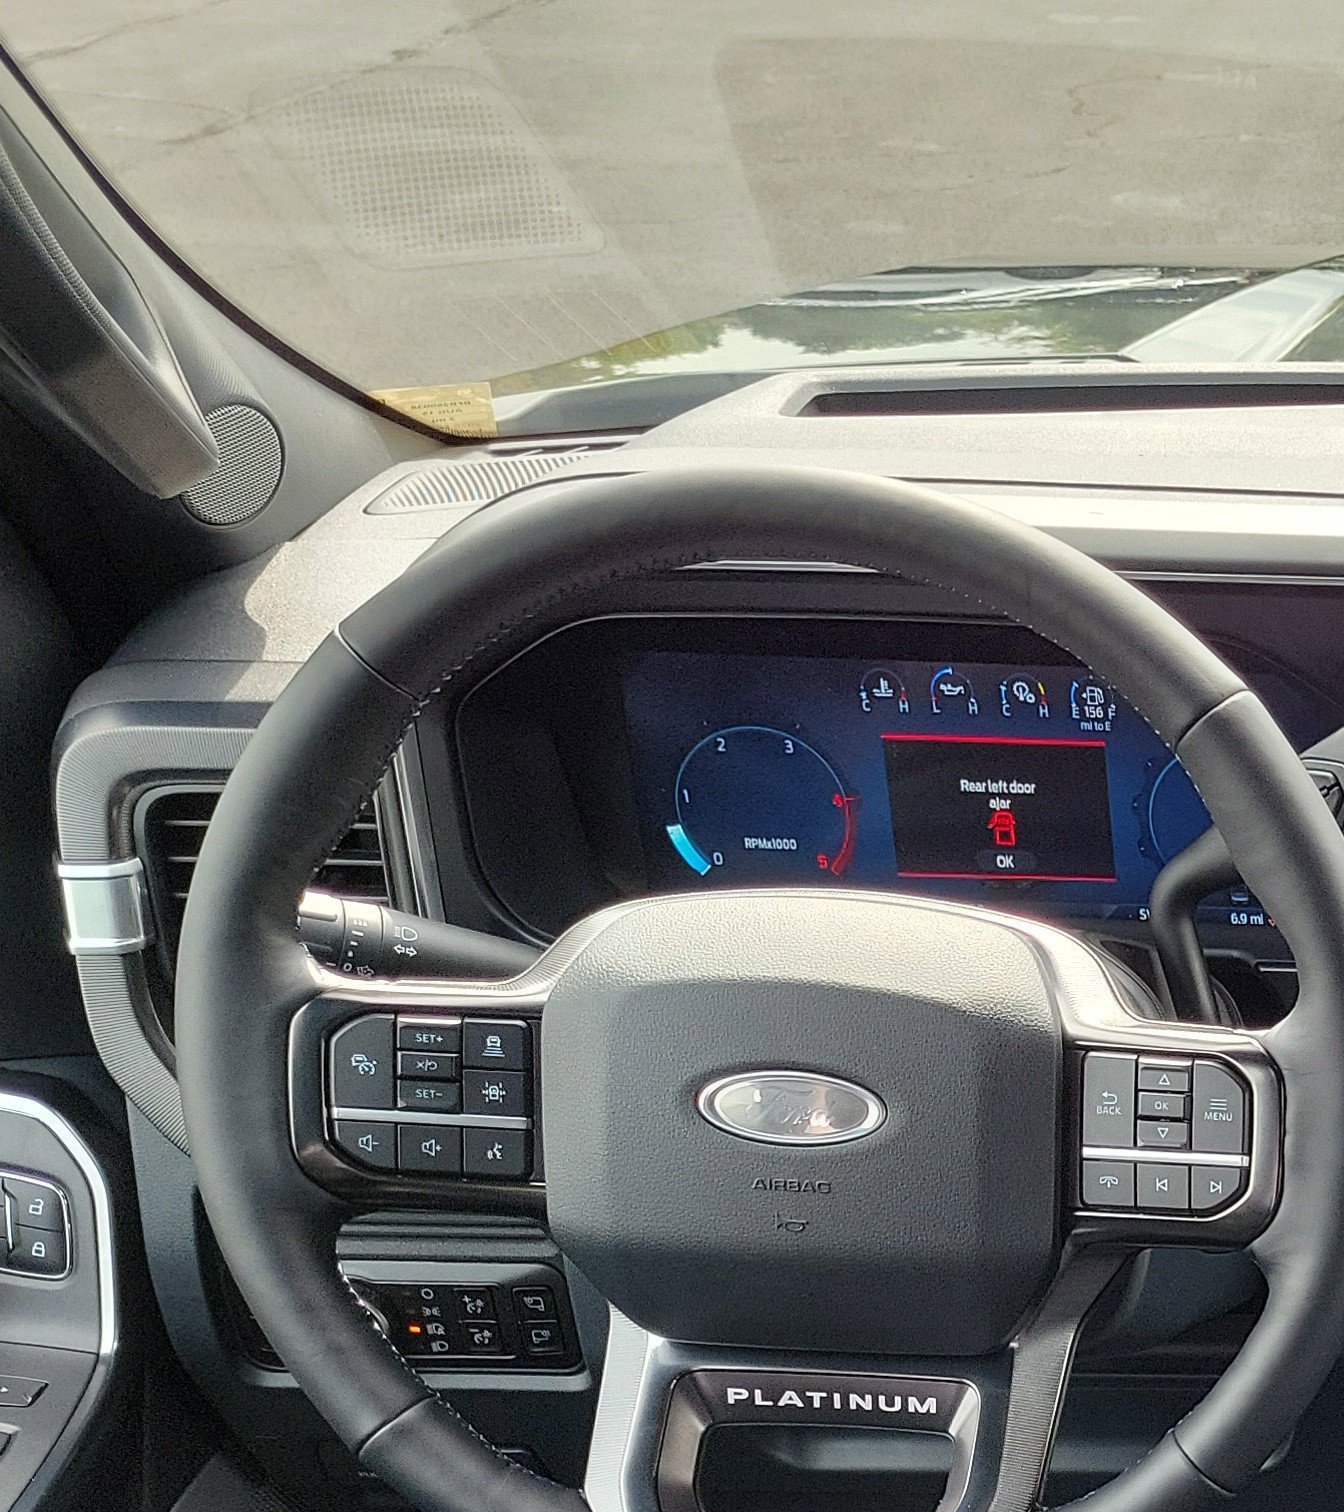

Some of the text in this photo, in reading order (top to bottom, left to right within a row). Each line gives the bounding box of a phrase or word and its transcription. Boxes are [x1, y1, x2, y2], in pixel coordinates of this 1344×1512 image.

[1084, 706, 1104, 719] 156
[1094, 721, 1104, 731] to
[1105, 721, 1112, 731] E
[716, 737, 726, 752] 2
[784, 739, 794, 753] 3
[960, 779, 1036, 795] Rear left door
[989, 796, 1012, 811] ajar
[743, 836, 797, 850] RPMx1000
[996, 855, 1015, 868] OK
[1230, 913, 1264, 925] 6.9 mi
[1096, 1106, 1122, 1115] BACK
[1154, 1101, 1169, 1111] OK
[1203, 1111, 1233, 1122] MENU
[750, 1177, 832, 1195] AIRBAG
[726, 1387, 938, 1414] PLATINUM
